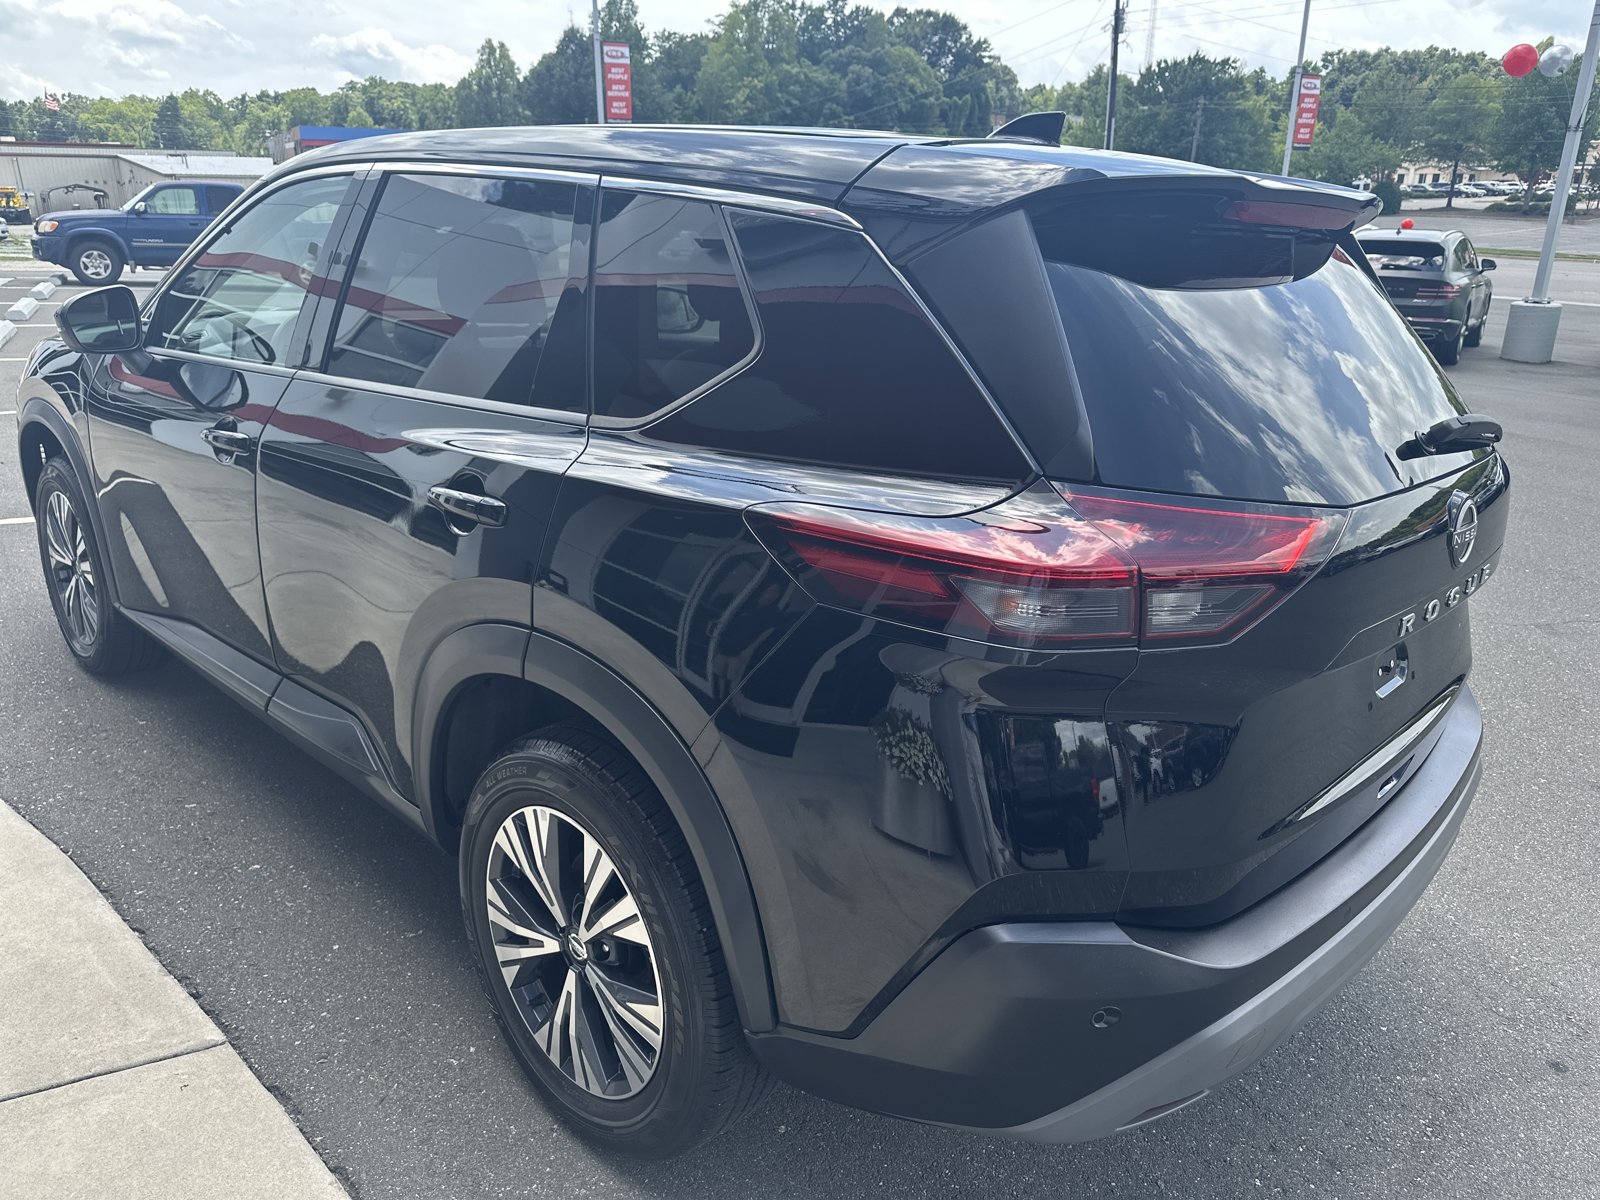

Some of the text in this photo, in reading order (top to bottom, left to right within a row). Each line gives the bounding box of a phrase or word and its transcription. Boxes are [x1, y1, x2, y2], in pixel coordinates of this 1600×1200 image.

[1454, 528, 1477, 545] NISS
[1397, 563, 1491, 638] ROGUE
[486, 766, 527, 789] ALL WEATHER
